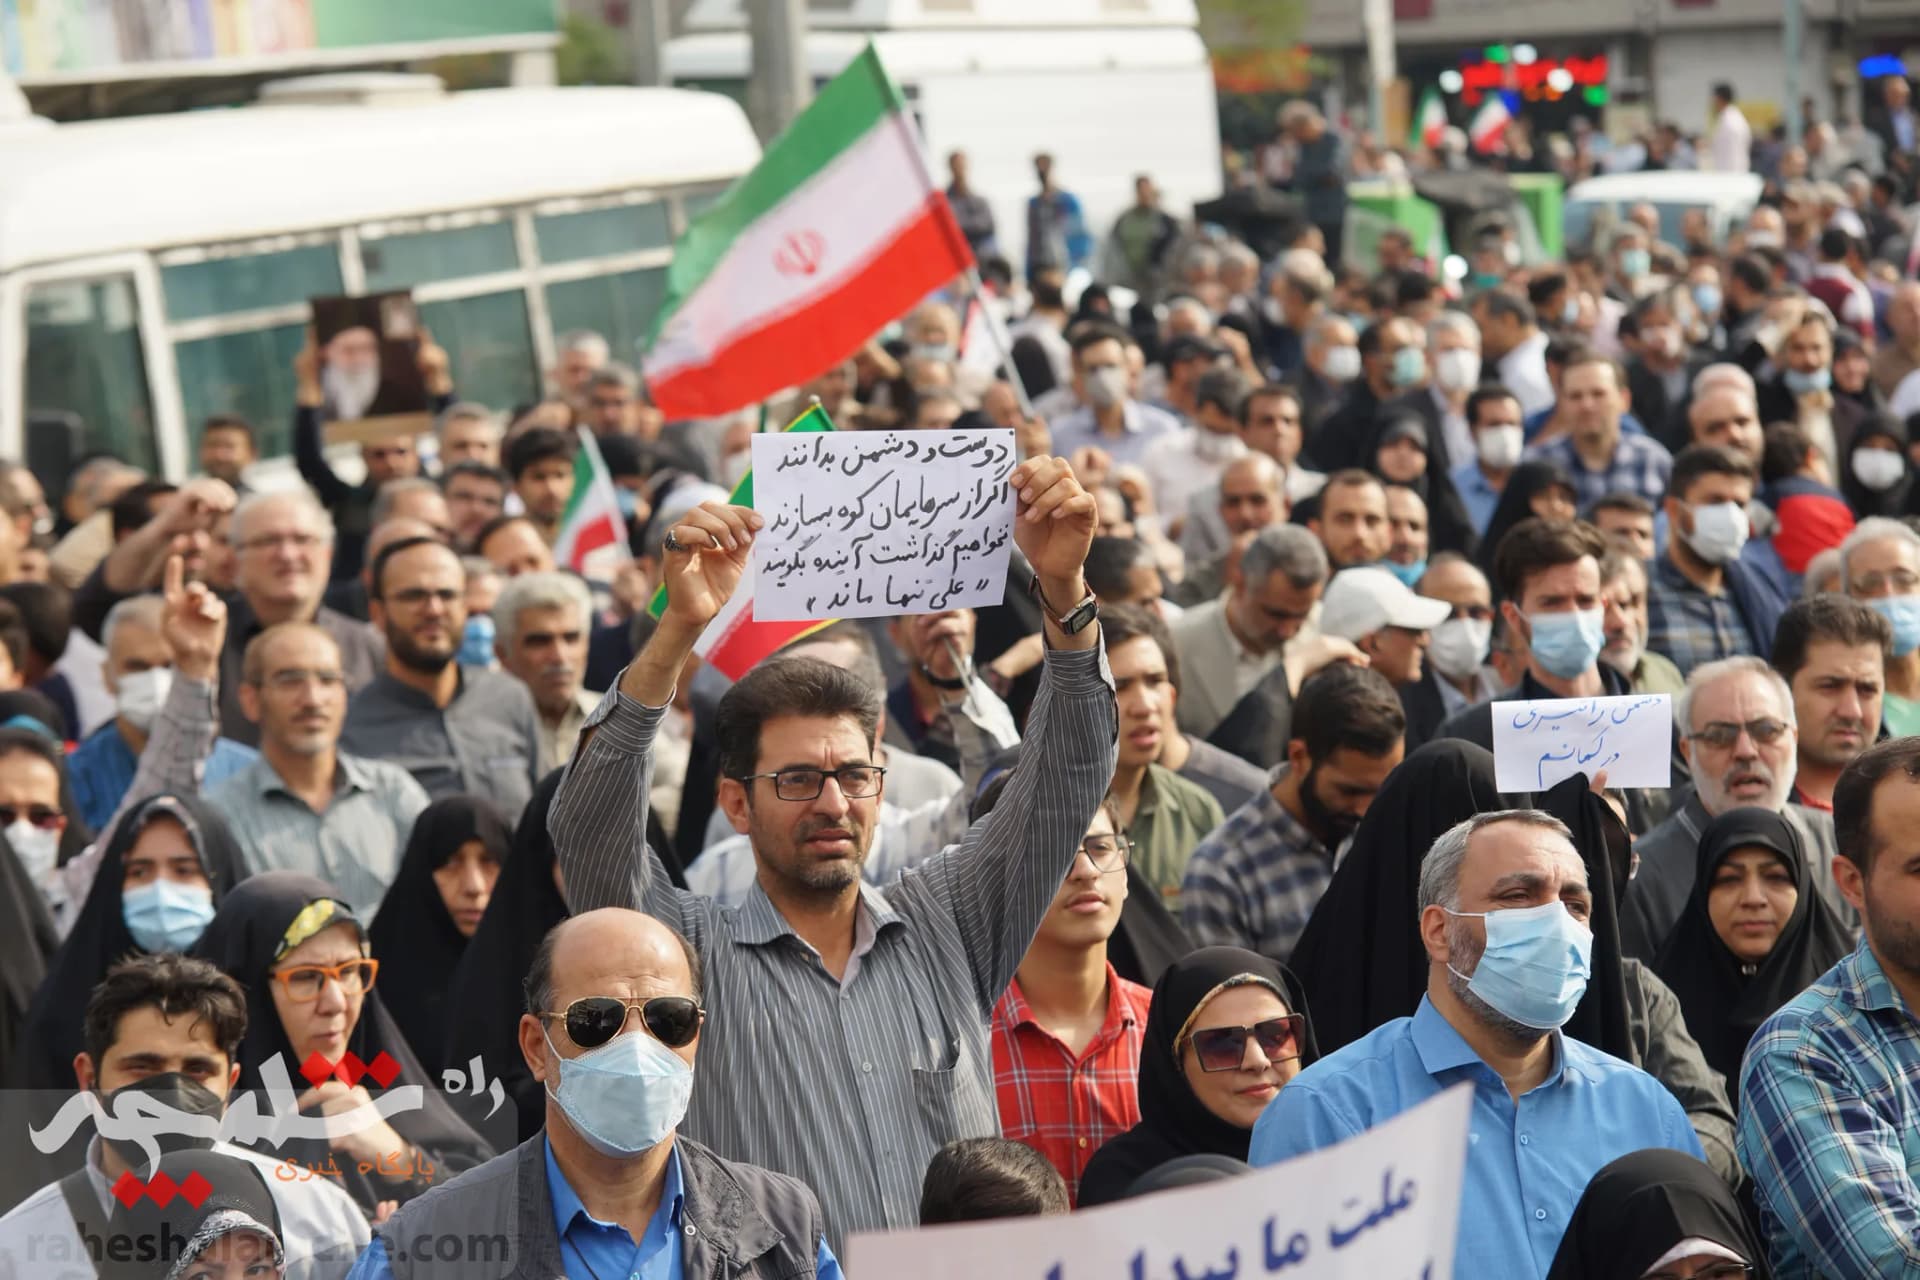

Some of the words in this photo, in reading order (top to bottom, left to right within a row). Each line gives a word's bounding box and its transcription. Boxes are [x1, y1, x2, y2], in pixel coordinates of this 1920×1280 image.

[776, 435, 835, 472] بدانند
[841, 433, 919, 476] دشمن
[921, 447, 936, 463] و
[938, 435, 1008, 468] دوست
[838, 469, 895, 531] کوه
[958, 478, 984, 519] از
[972, 460, 1015, 519] اگر
[770, 493, 833, 540] بسازند
[762, 533, 822, 587] بگویند
[813, 533, 874, 576] آینده
[869, 528, 963, 567] گذاشت
[951, 524, 1009, 575] نخواهیم
[886, 575, 933, 607] تنها
[1329, 1165, 1417, 1249] ملت
[1262, 1214, 1310, 1274] ما
